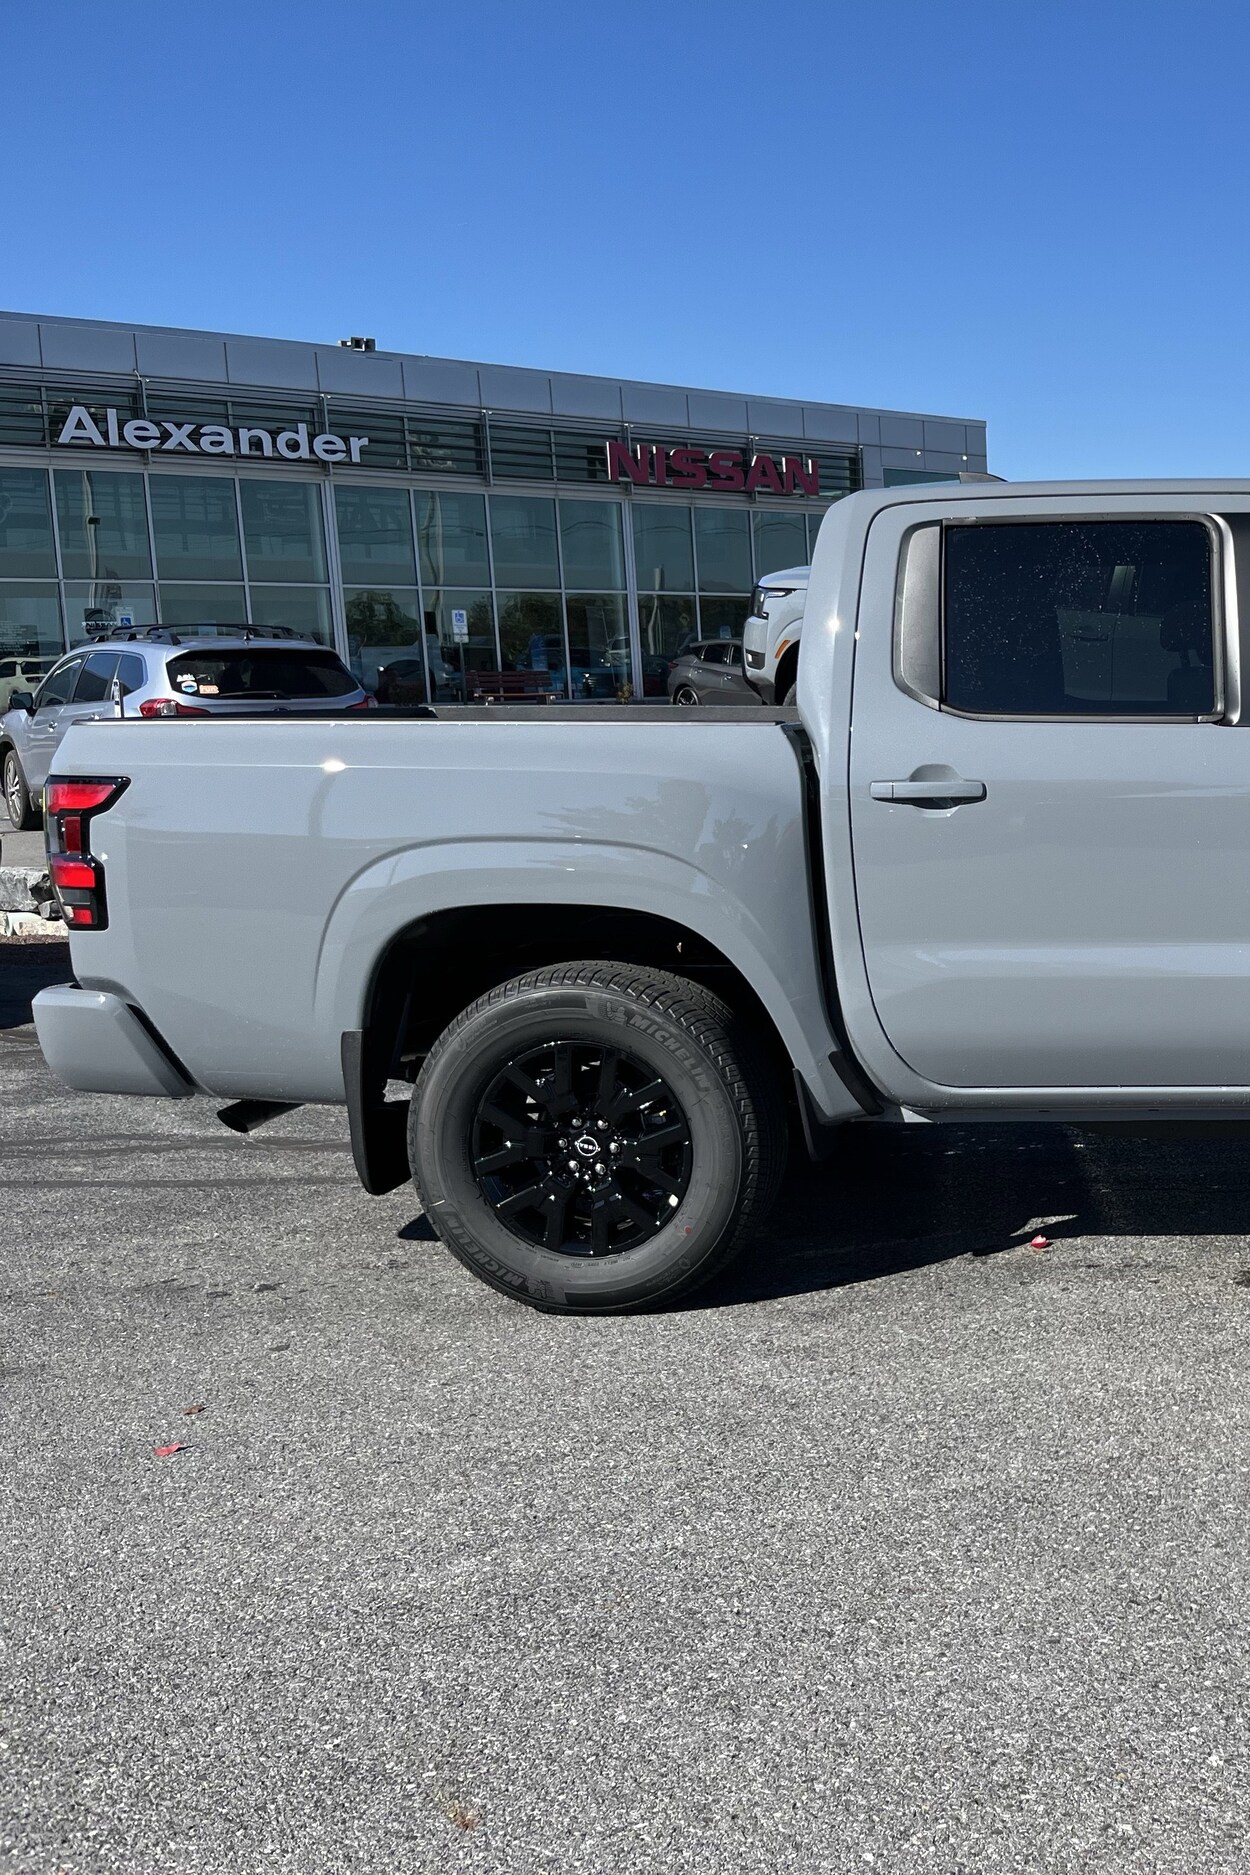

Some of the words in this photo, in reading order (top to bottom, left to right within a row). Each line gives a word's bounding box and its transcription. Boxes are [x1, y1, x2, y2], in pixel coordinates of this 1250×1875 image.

[57, 405, 369, 463] Alexander
[606, 440, 821, 497] NISSAN
[631, 1013, 711, 1090] MICHELIN
[443, 1214, 524, 1287] MICHELIN
